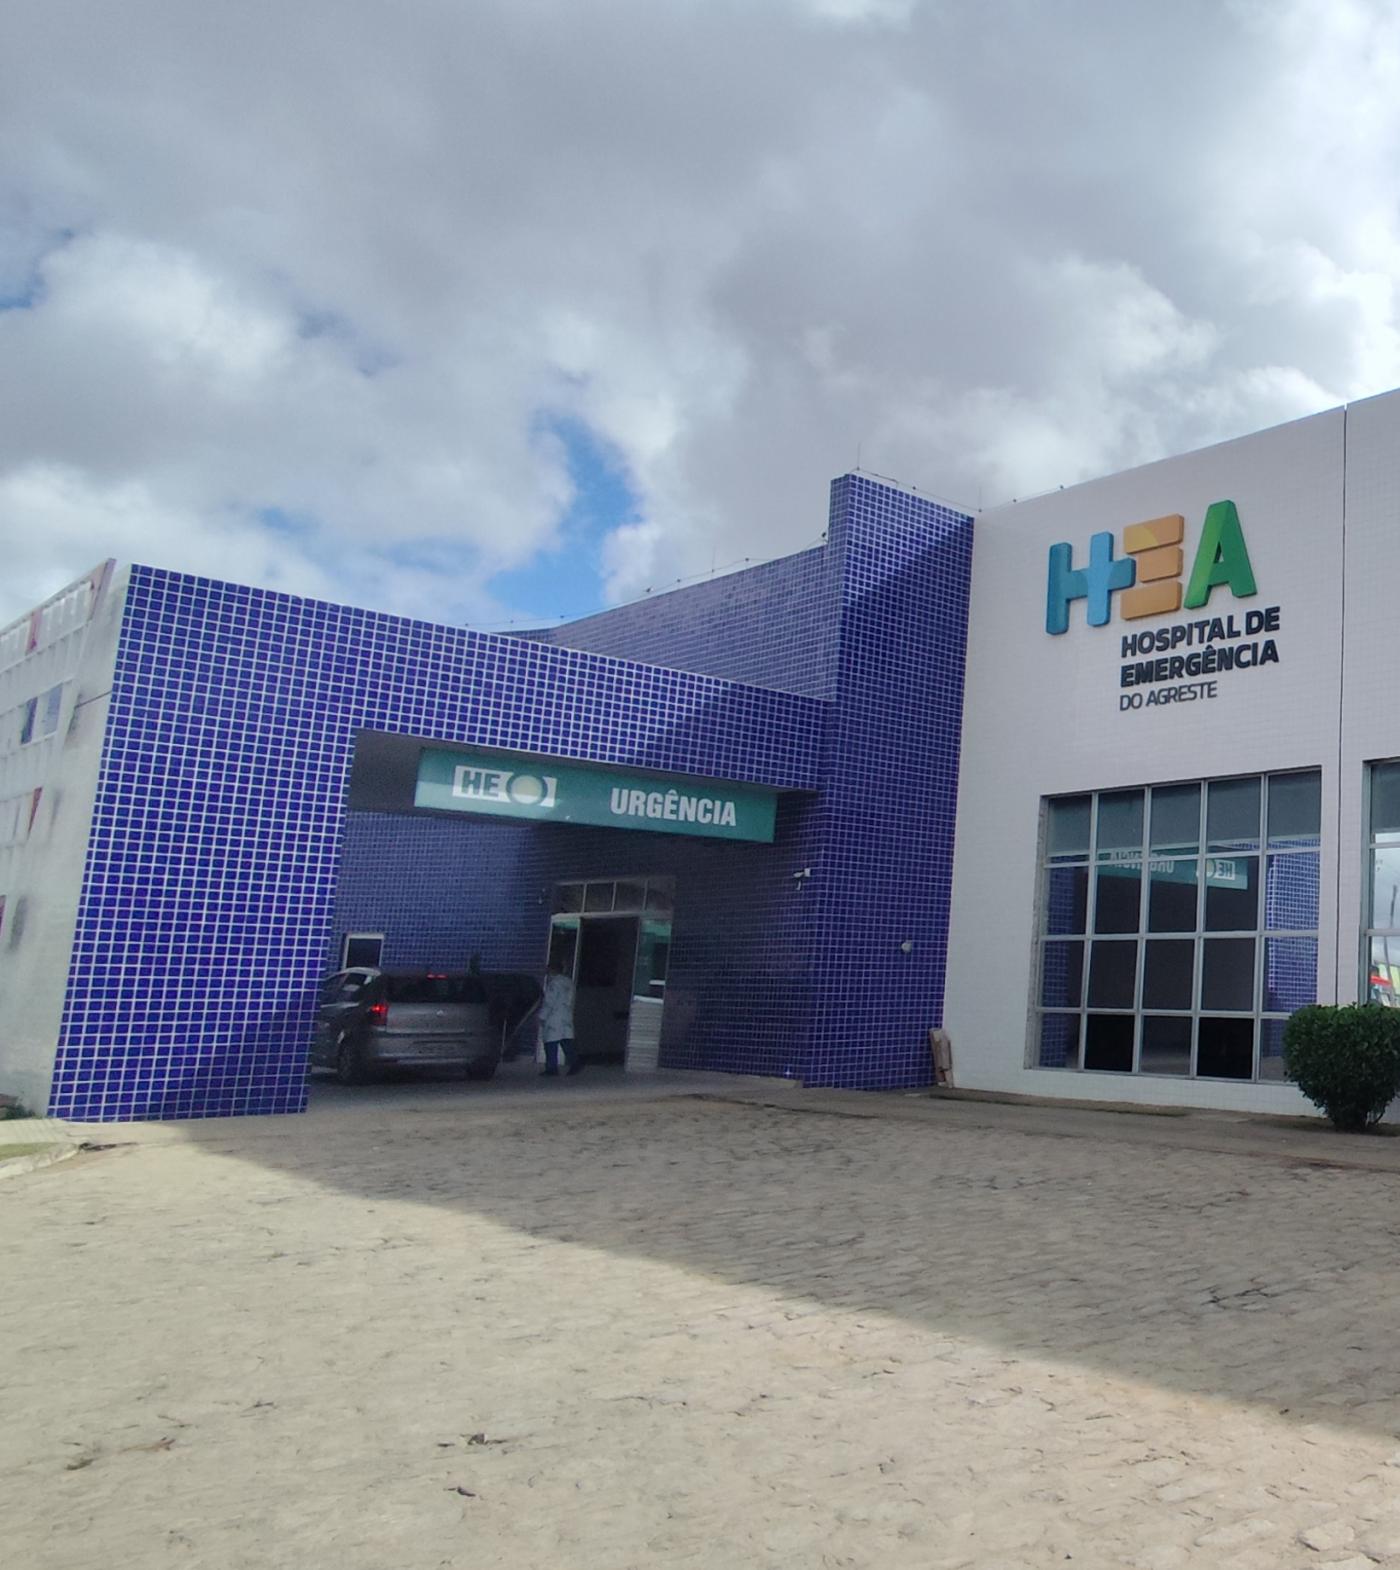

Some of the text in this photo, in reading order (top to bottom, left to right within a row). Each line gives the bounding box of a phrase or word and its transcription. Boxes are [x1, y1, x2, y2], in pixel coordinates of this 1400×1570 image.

[1121, 606, 1280, 658] HOSPITAL DE
[1120, 639, 1279, 688] EMERGÊNCIA
[1119, 681, 1218, 711] DO AGRESTE
[610, 787, 736, 827] URGÊNCIA
